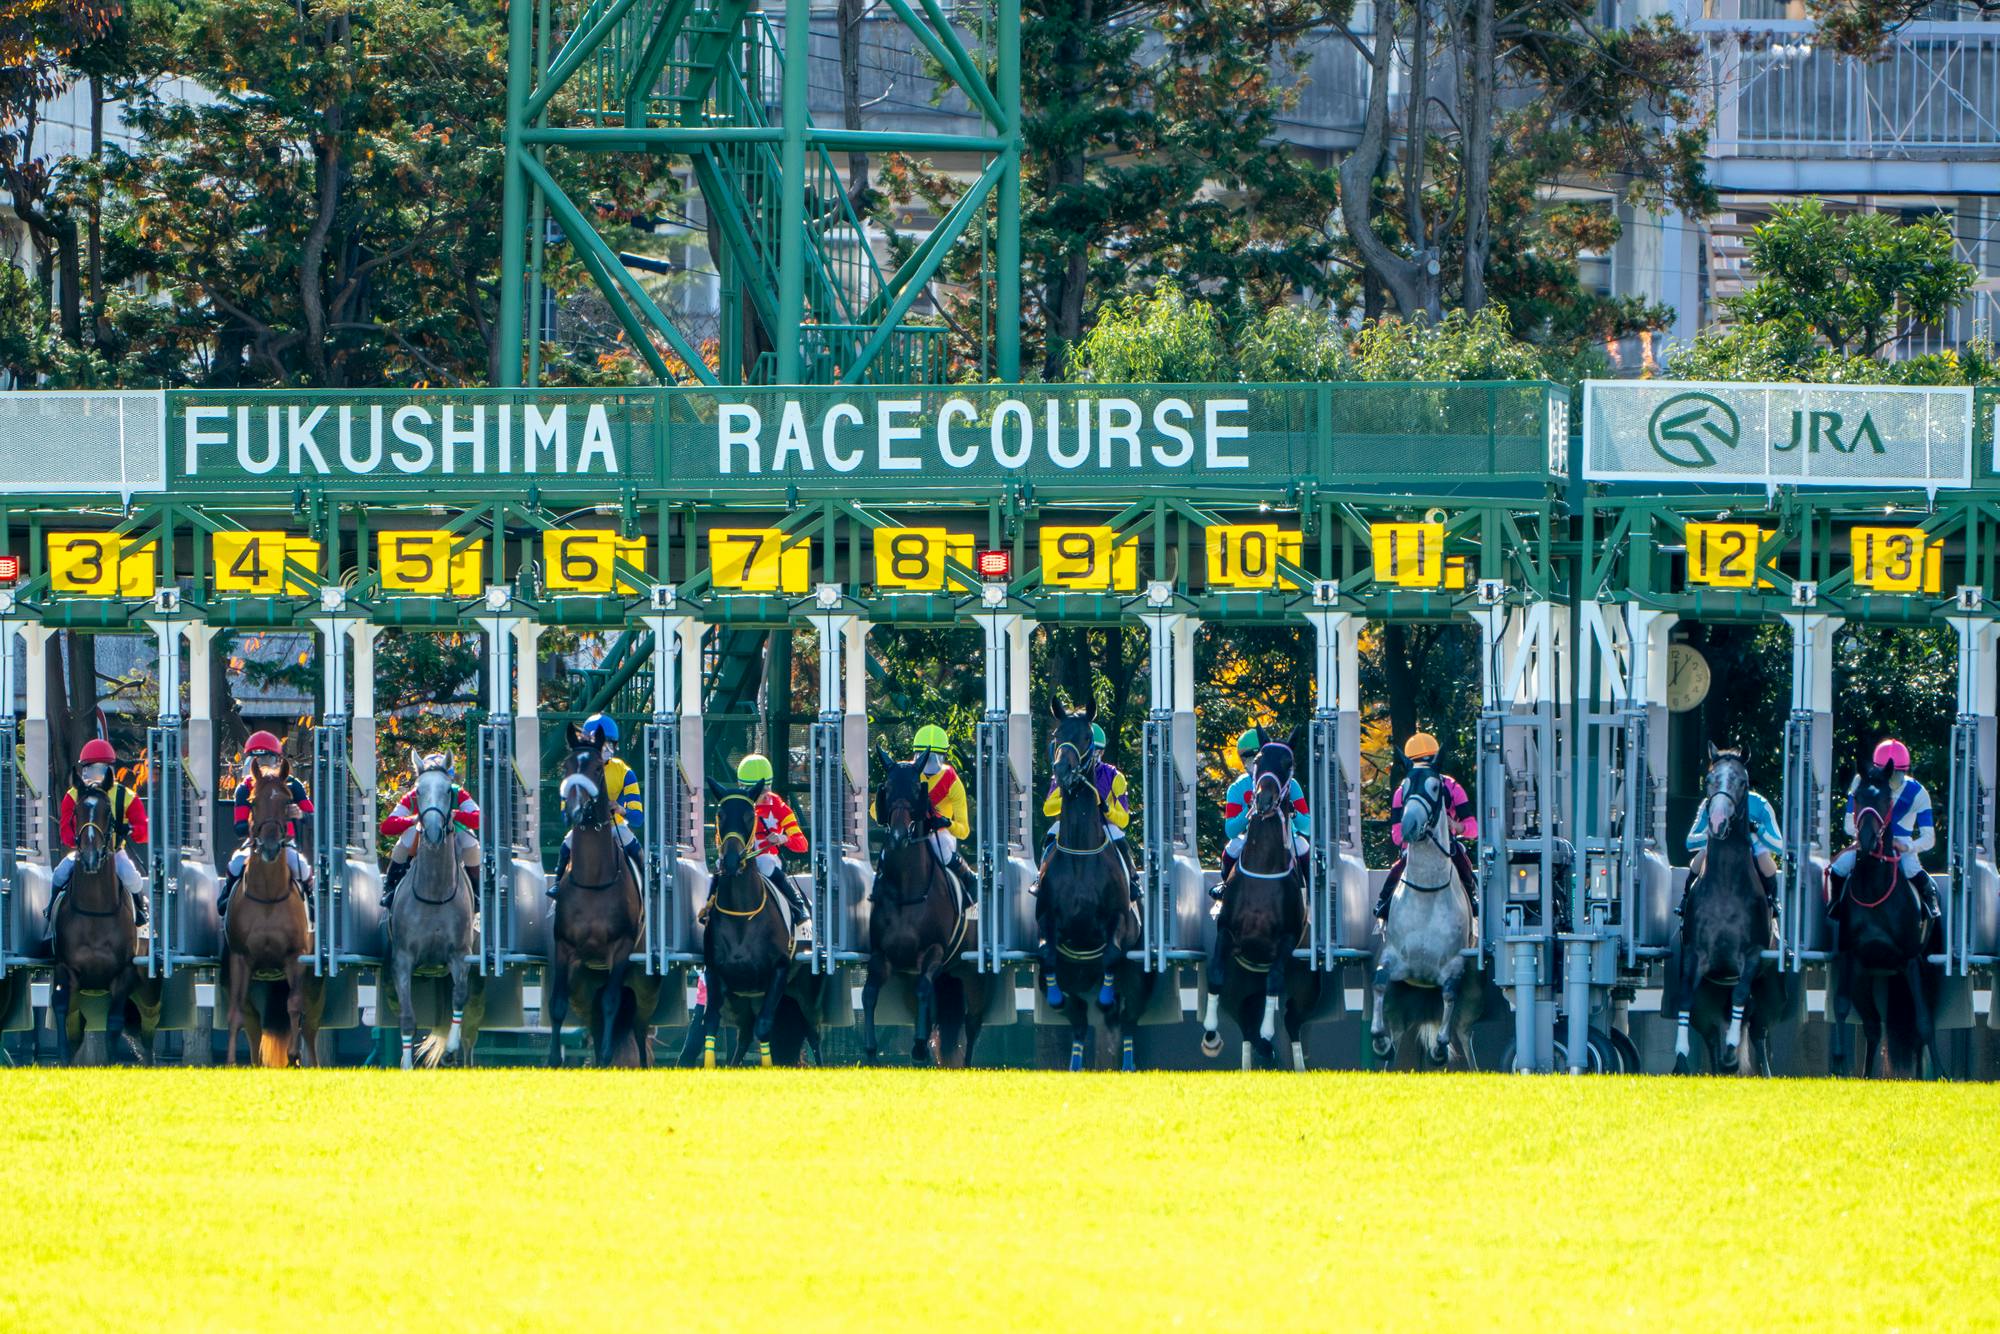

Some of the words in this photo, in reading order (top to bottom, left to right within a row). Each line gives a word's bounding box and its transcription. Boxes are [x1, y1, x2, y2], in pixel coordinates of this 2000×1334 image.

[185, 404, 618, 475] FUKUSHIMA
[718, 398, 1250, 474] RACECOURSE
[1773, 410, 1886, 454] JRA
[65, 539, 103, 585] 3
[229, 537, 269, 586] 4
[395, 537, 433, 583] 5
[560, 536, 599, 582] 6
[726, 534, 764, 582] 7
[890, 534, 930, 581] 8
[1056, 532, 1096, 580] 9
[1219, 530, 1267, 578] 10
[1389, 529, 1426, 577] 11
[1699, 529, 1747, 577] 12
[1865, 533, 1914, 581] 13
